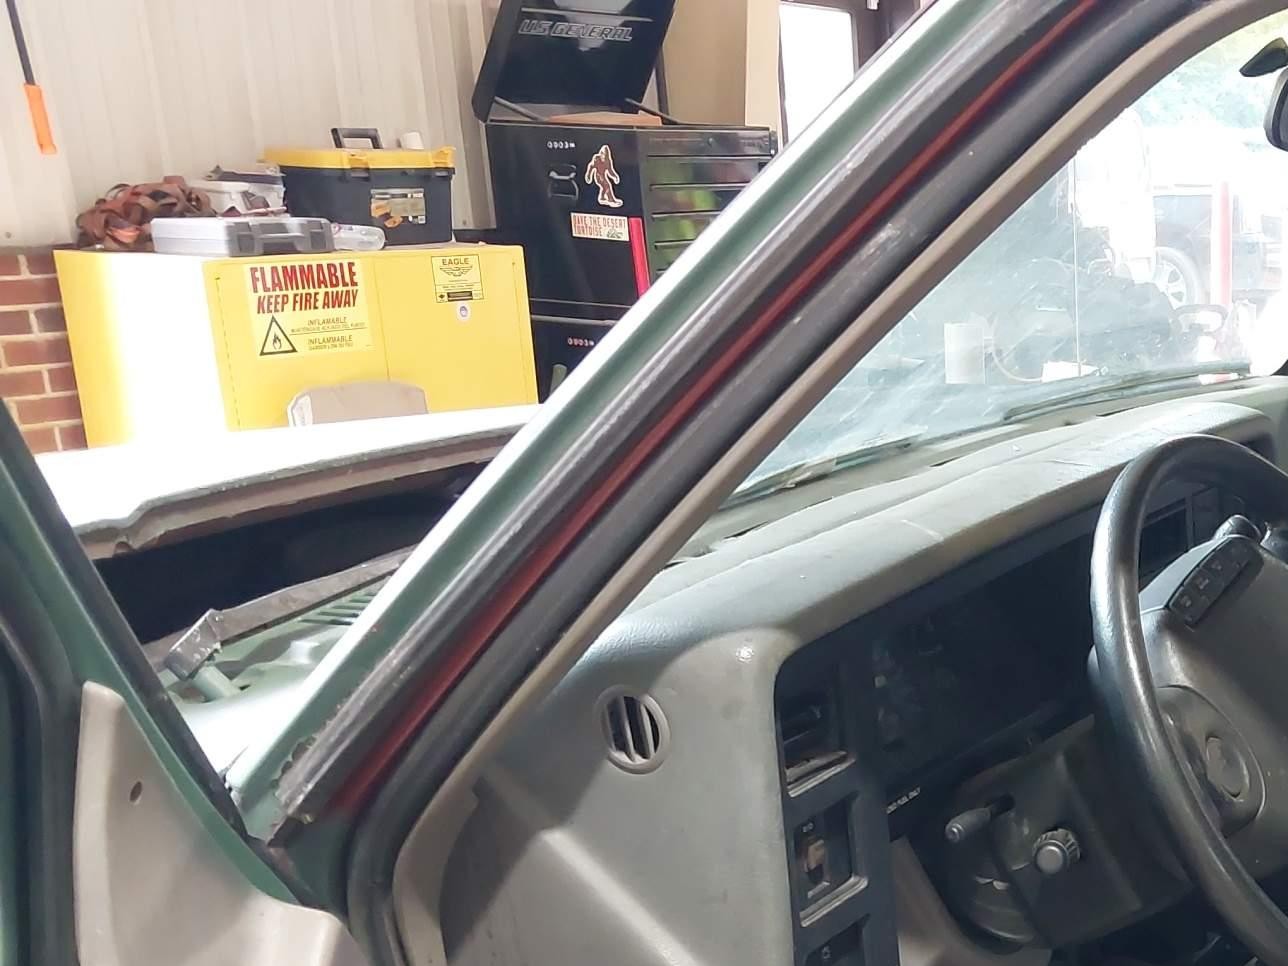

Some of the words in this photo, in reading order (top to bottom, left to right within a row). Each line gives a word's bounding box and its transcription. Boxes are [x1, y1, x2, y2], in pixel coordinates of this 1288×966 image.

[518, 20, 553, 35] US
[550, 22, 633, 41] GENERAL
[602, 217, 627, 229] DESERT
[441, 257, 470, 266] EAGLE
[250, 262, 359, 293] FLAMMABLE
[257, 294, 289, 315] KEEP
[292, 291, 320, 312] FIRE
[322, 289, 359, 310] AWAY
